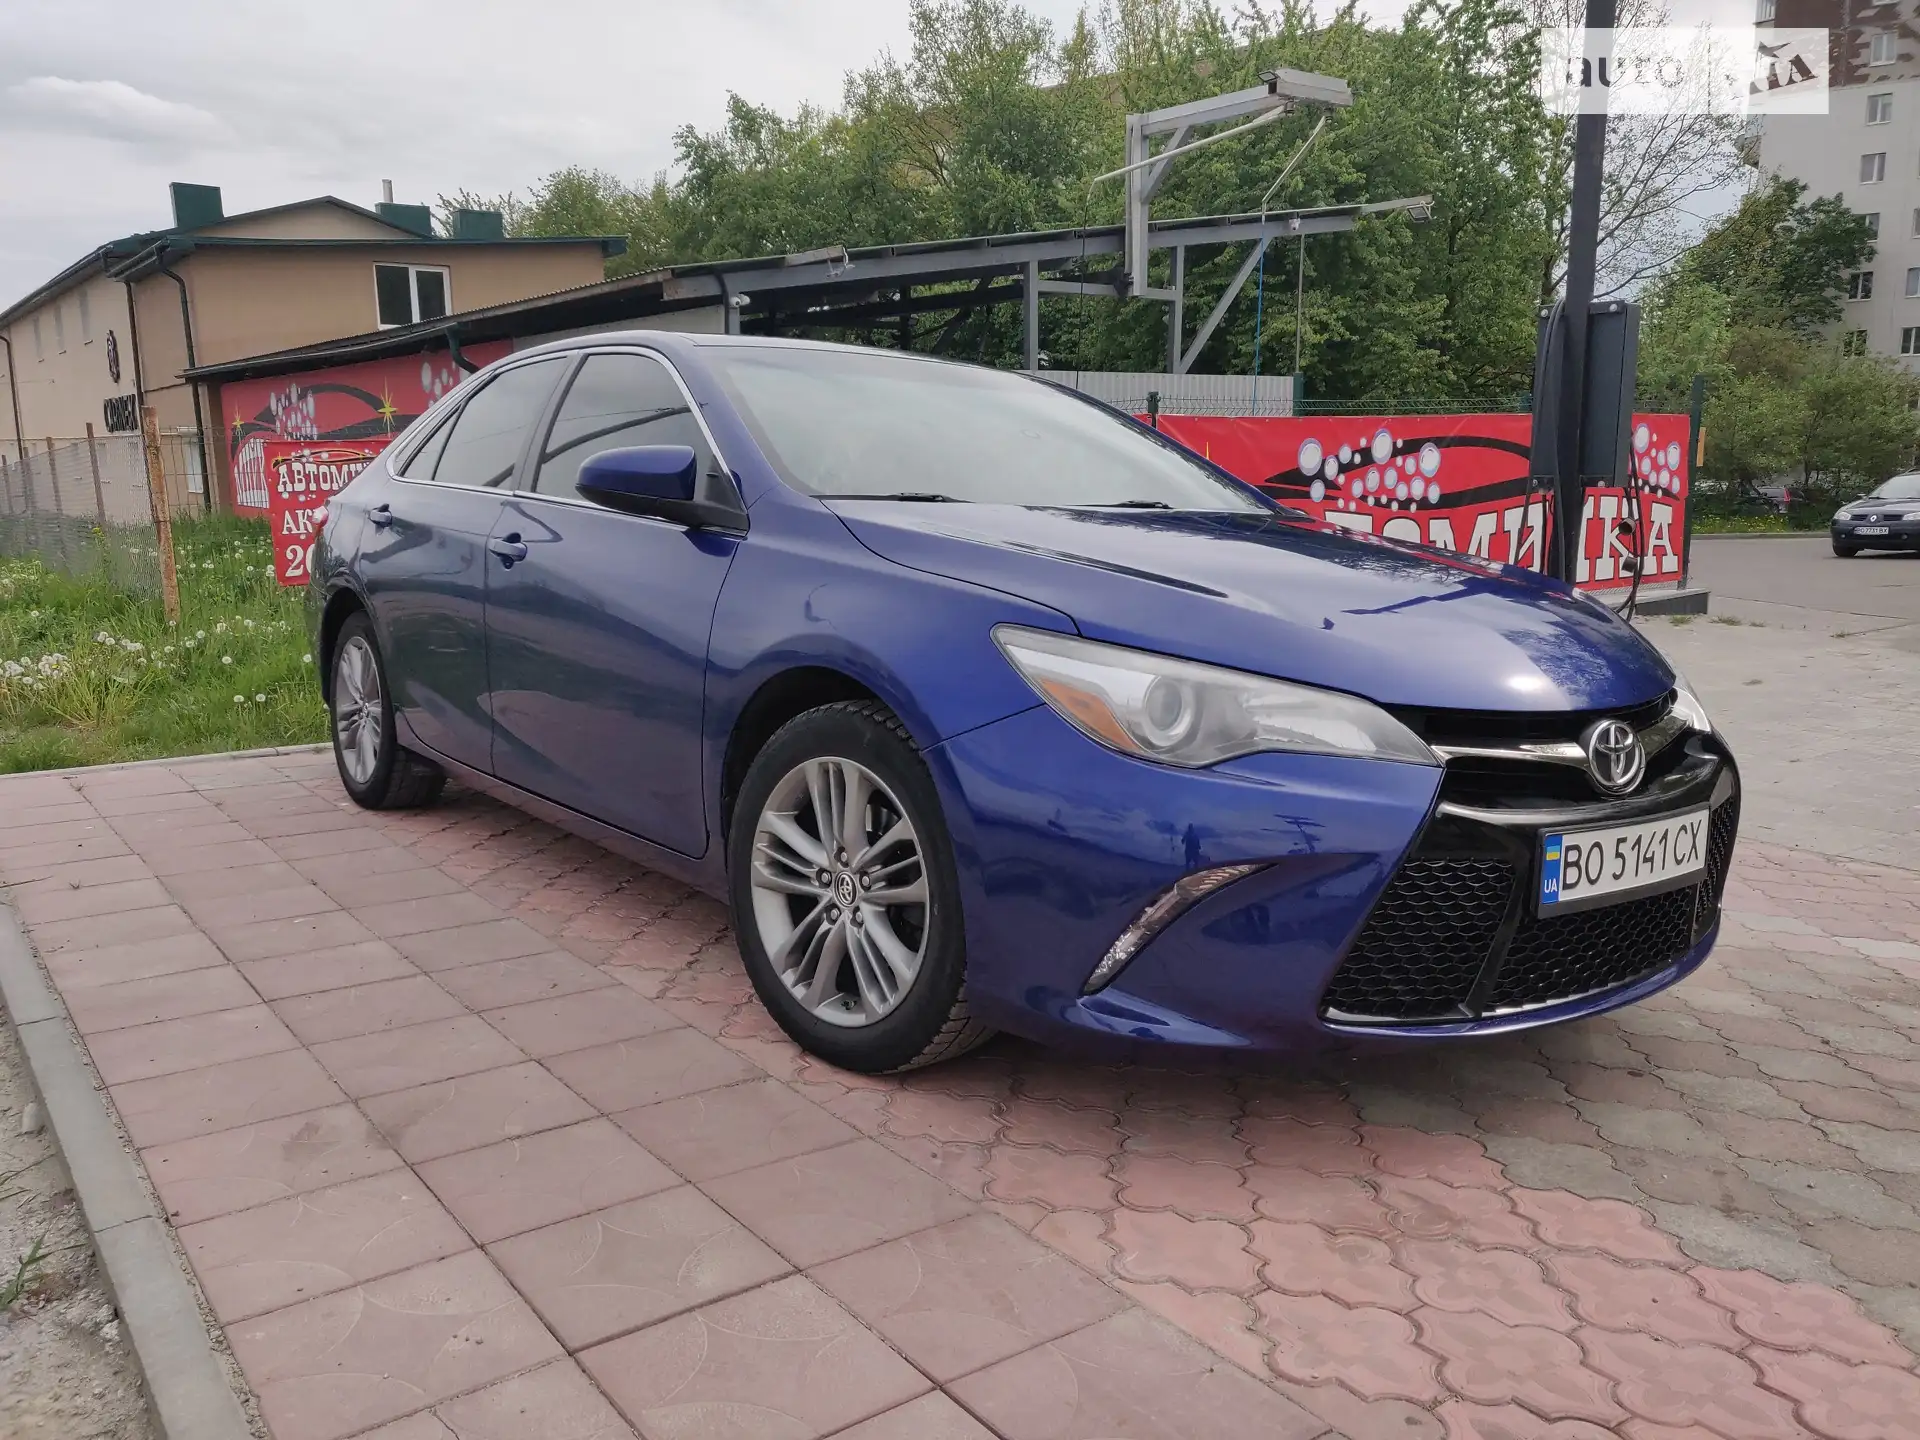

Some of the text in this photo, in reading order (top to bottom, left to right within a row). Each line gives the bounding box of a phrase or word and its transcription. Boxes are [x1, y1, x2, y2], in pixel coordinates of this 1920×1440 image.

[281, 508, 315, 535] АК
[1562, 818, 1703, 891] BO 5141 CX
[1543, 878, 1558, 893] UA
